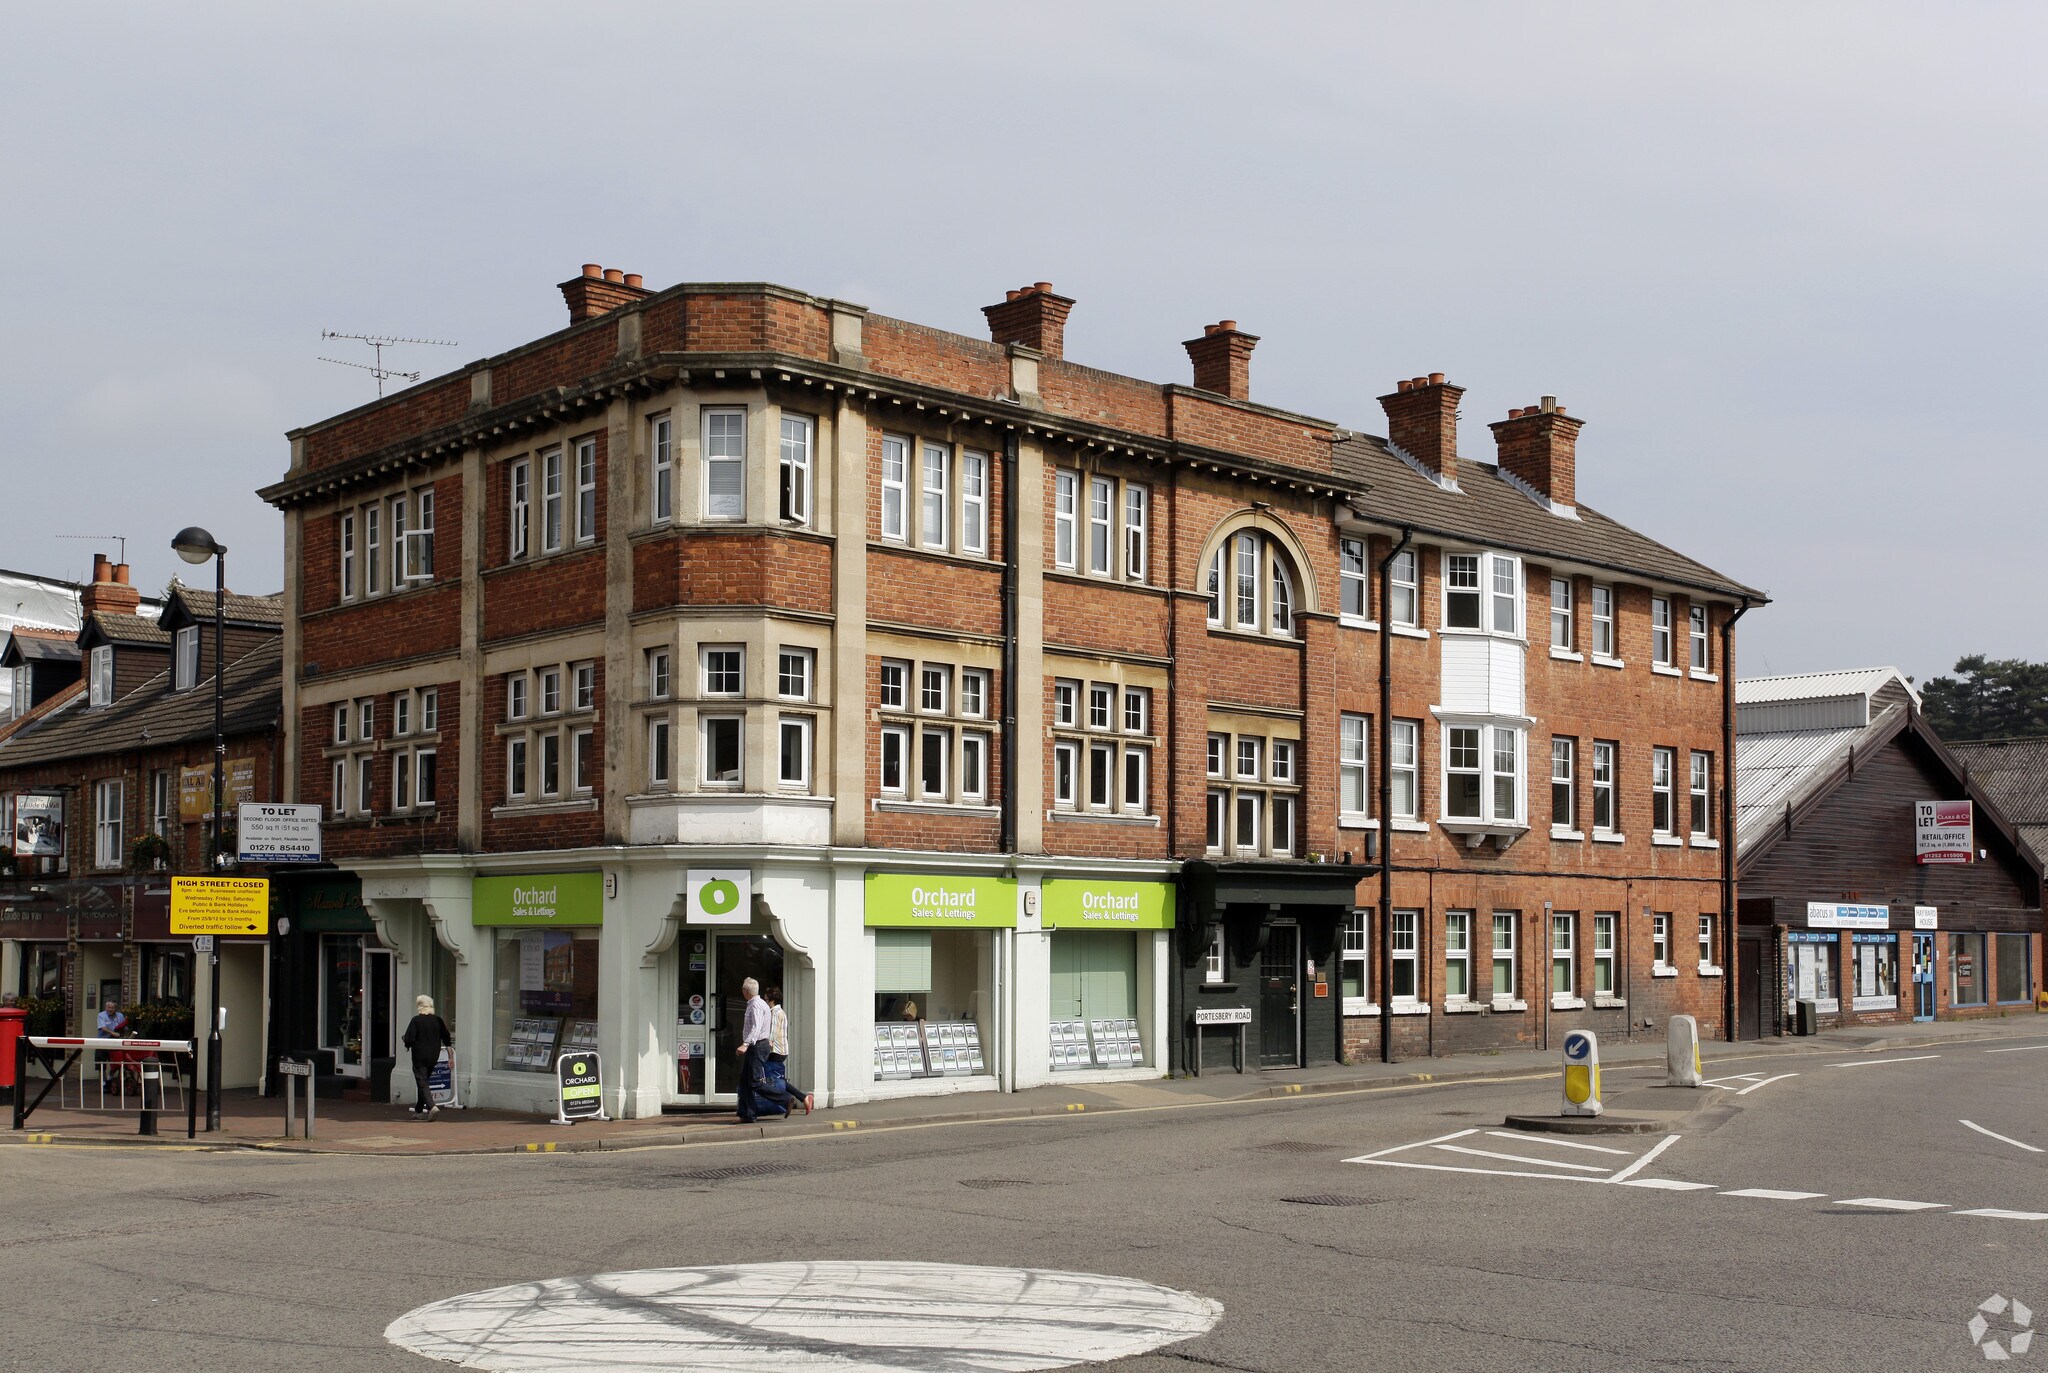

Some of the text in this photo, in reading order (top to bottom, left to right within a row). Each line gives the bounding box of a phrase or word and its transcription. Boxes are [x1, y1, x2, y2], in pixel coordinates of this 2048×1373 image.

[1918, 806, 1934, 826] TO LET
[513, 886, 557, 905] Orchard
[912, 887, 976, 906] Orchard
[1082, 891, 1138, 909] Orchard
[513, 906, 556, 917] Sales & Lettings
[912, 908, 976, 920] Sales & Lettings
[1083, 910, 1139, 922] Sales & Lettings
[1809, 906, 1829, 918] abacus
[1916, 909, 1936, 917] HAYWARD
[1197, 1012, 1232, 1020] PORTESBERY
[280, 1063, 307, 1075] HIGH STREET
[565, 1076, 596, 1085] ORCHARD
[570, 1088, 594, 1097] OPEN
